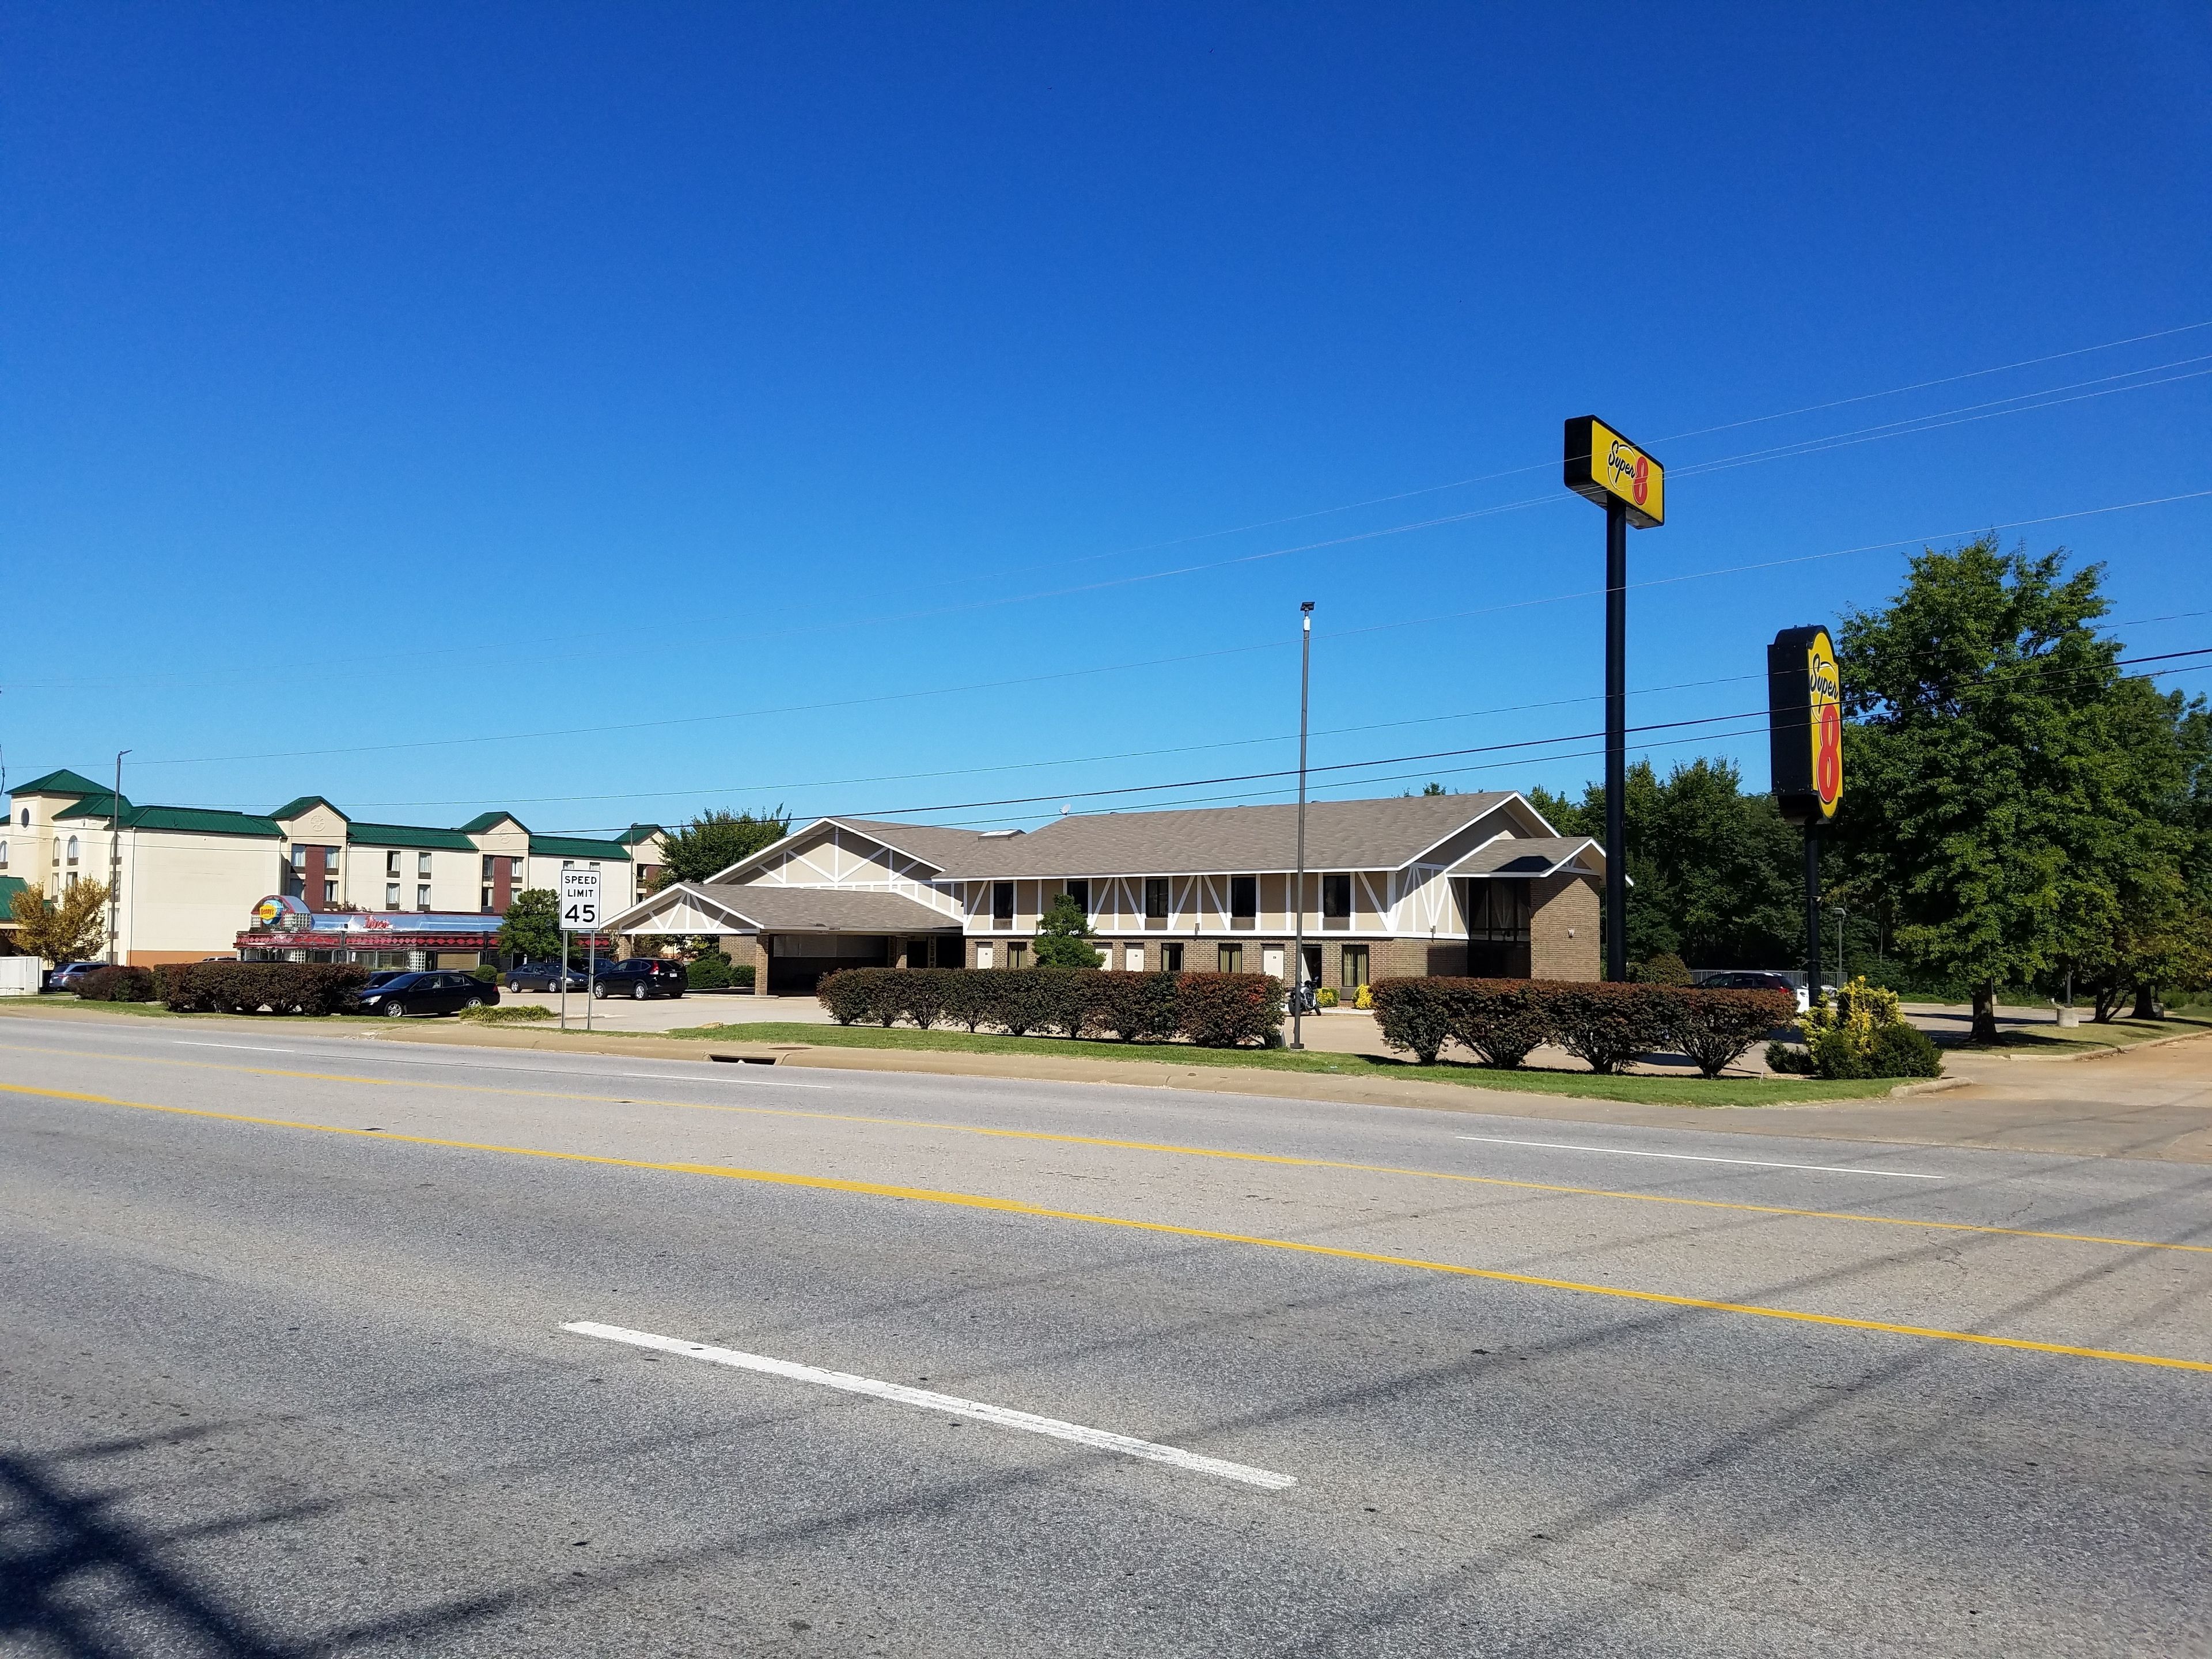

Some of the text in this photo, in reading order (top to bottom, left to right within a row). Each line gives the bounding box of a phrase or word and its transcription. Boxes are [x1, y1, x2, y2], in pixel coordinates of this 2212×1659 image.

[1608, 440, 1649, 506] Super 8
[1810, 653, 1838, 715] Super
[1817, 703, 1840, 804] 8
[565, 876, 597, 884] SPEED
[567, 889, 594, 897] LIMIT
[565, 904, 595, 923] 45
